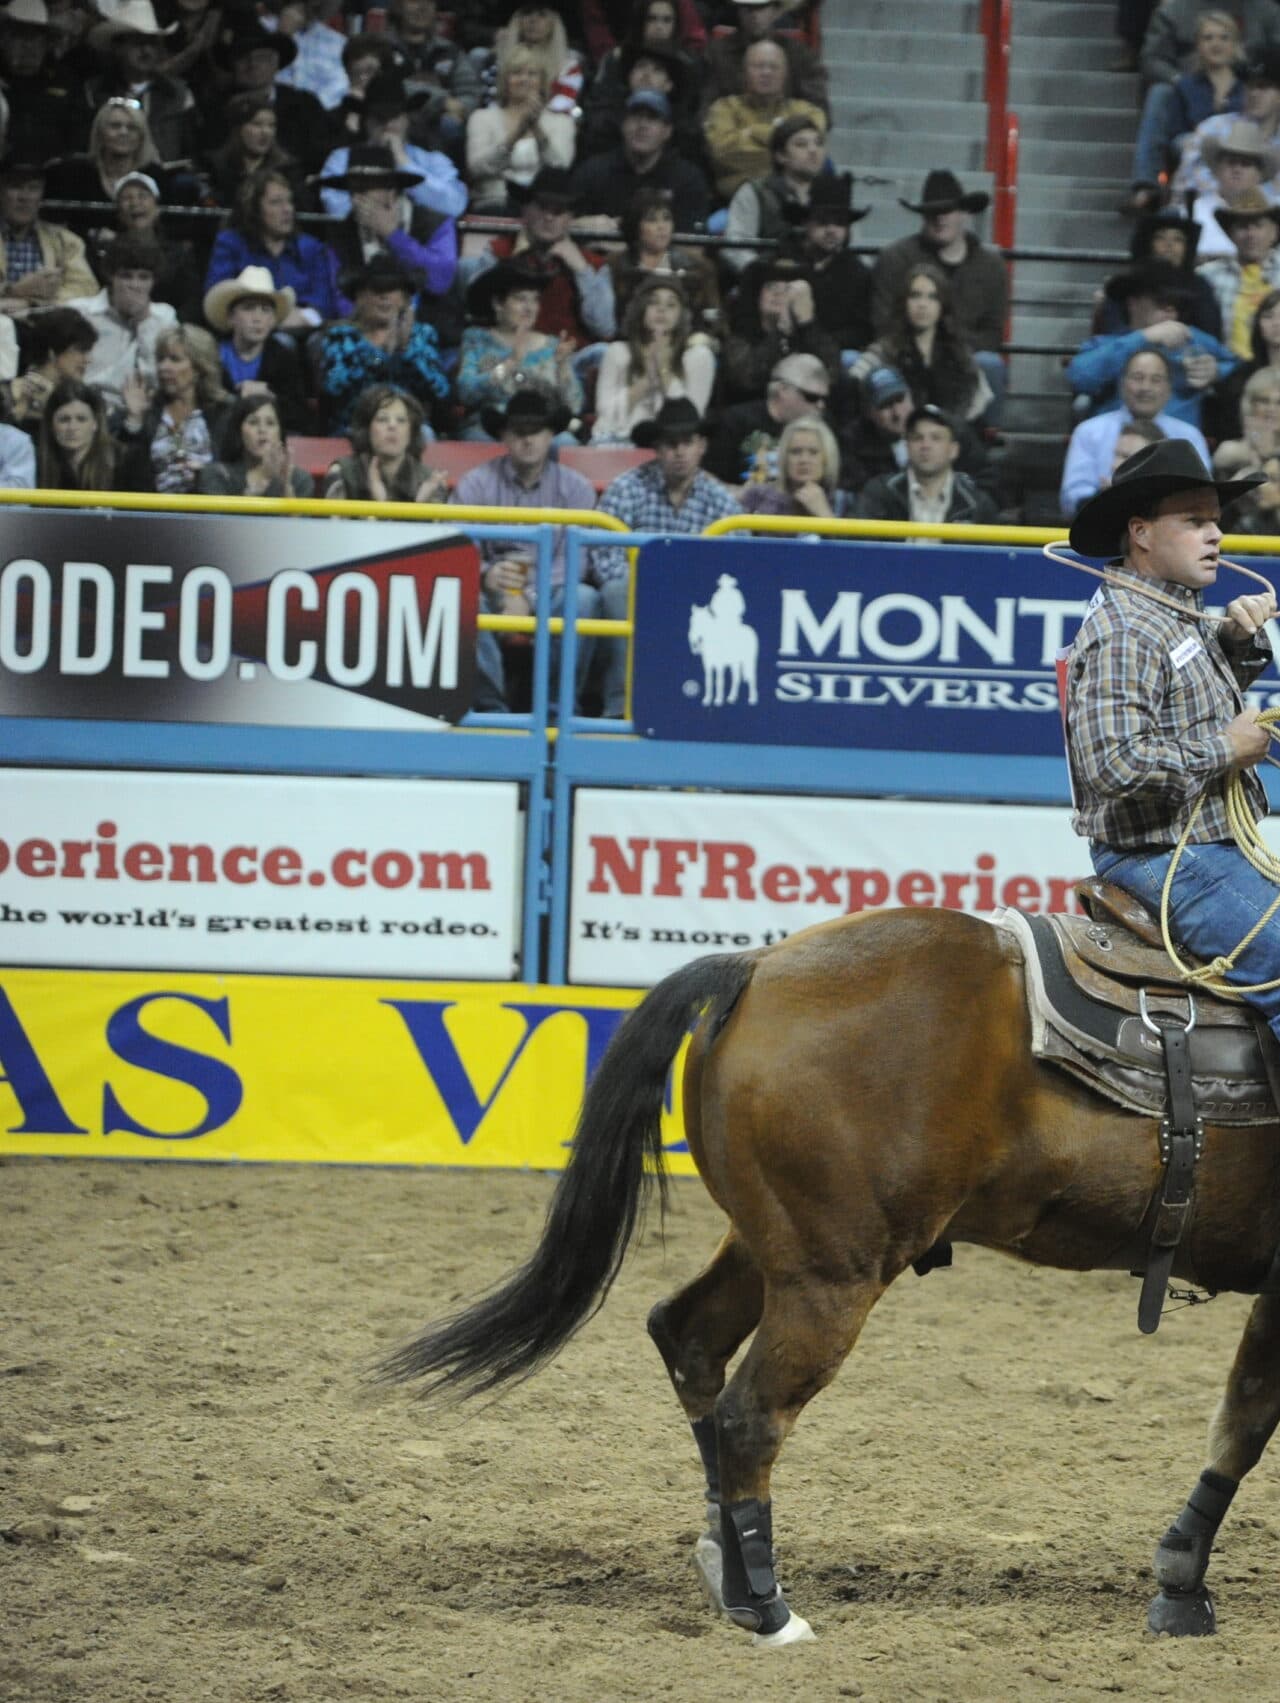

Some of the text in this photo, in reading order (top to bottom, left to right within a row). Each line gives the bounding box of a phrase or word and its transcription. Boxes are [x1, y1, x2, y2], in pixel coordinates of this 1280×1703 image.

[0, 558, 462, 690] ODEO.COM
[0, 820, 493, 891] erience.com
[57, 907, 197, 928] world's
[206, 913, 370, 933] greatest
[381, 917, 498, 936] rodeo.
[581, 920, 641, 940] It's
[650, 929, 752, 946] more
